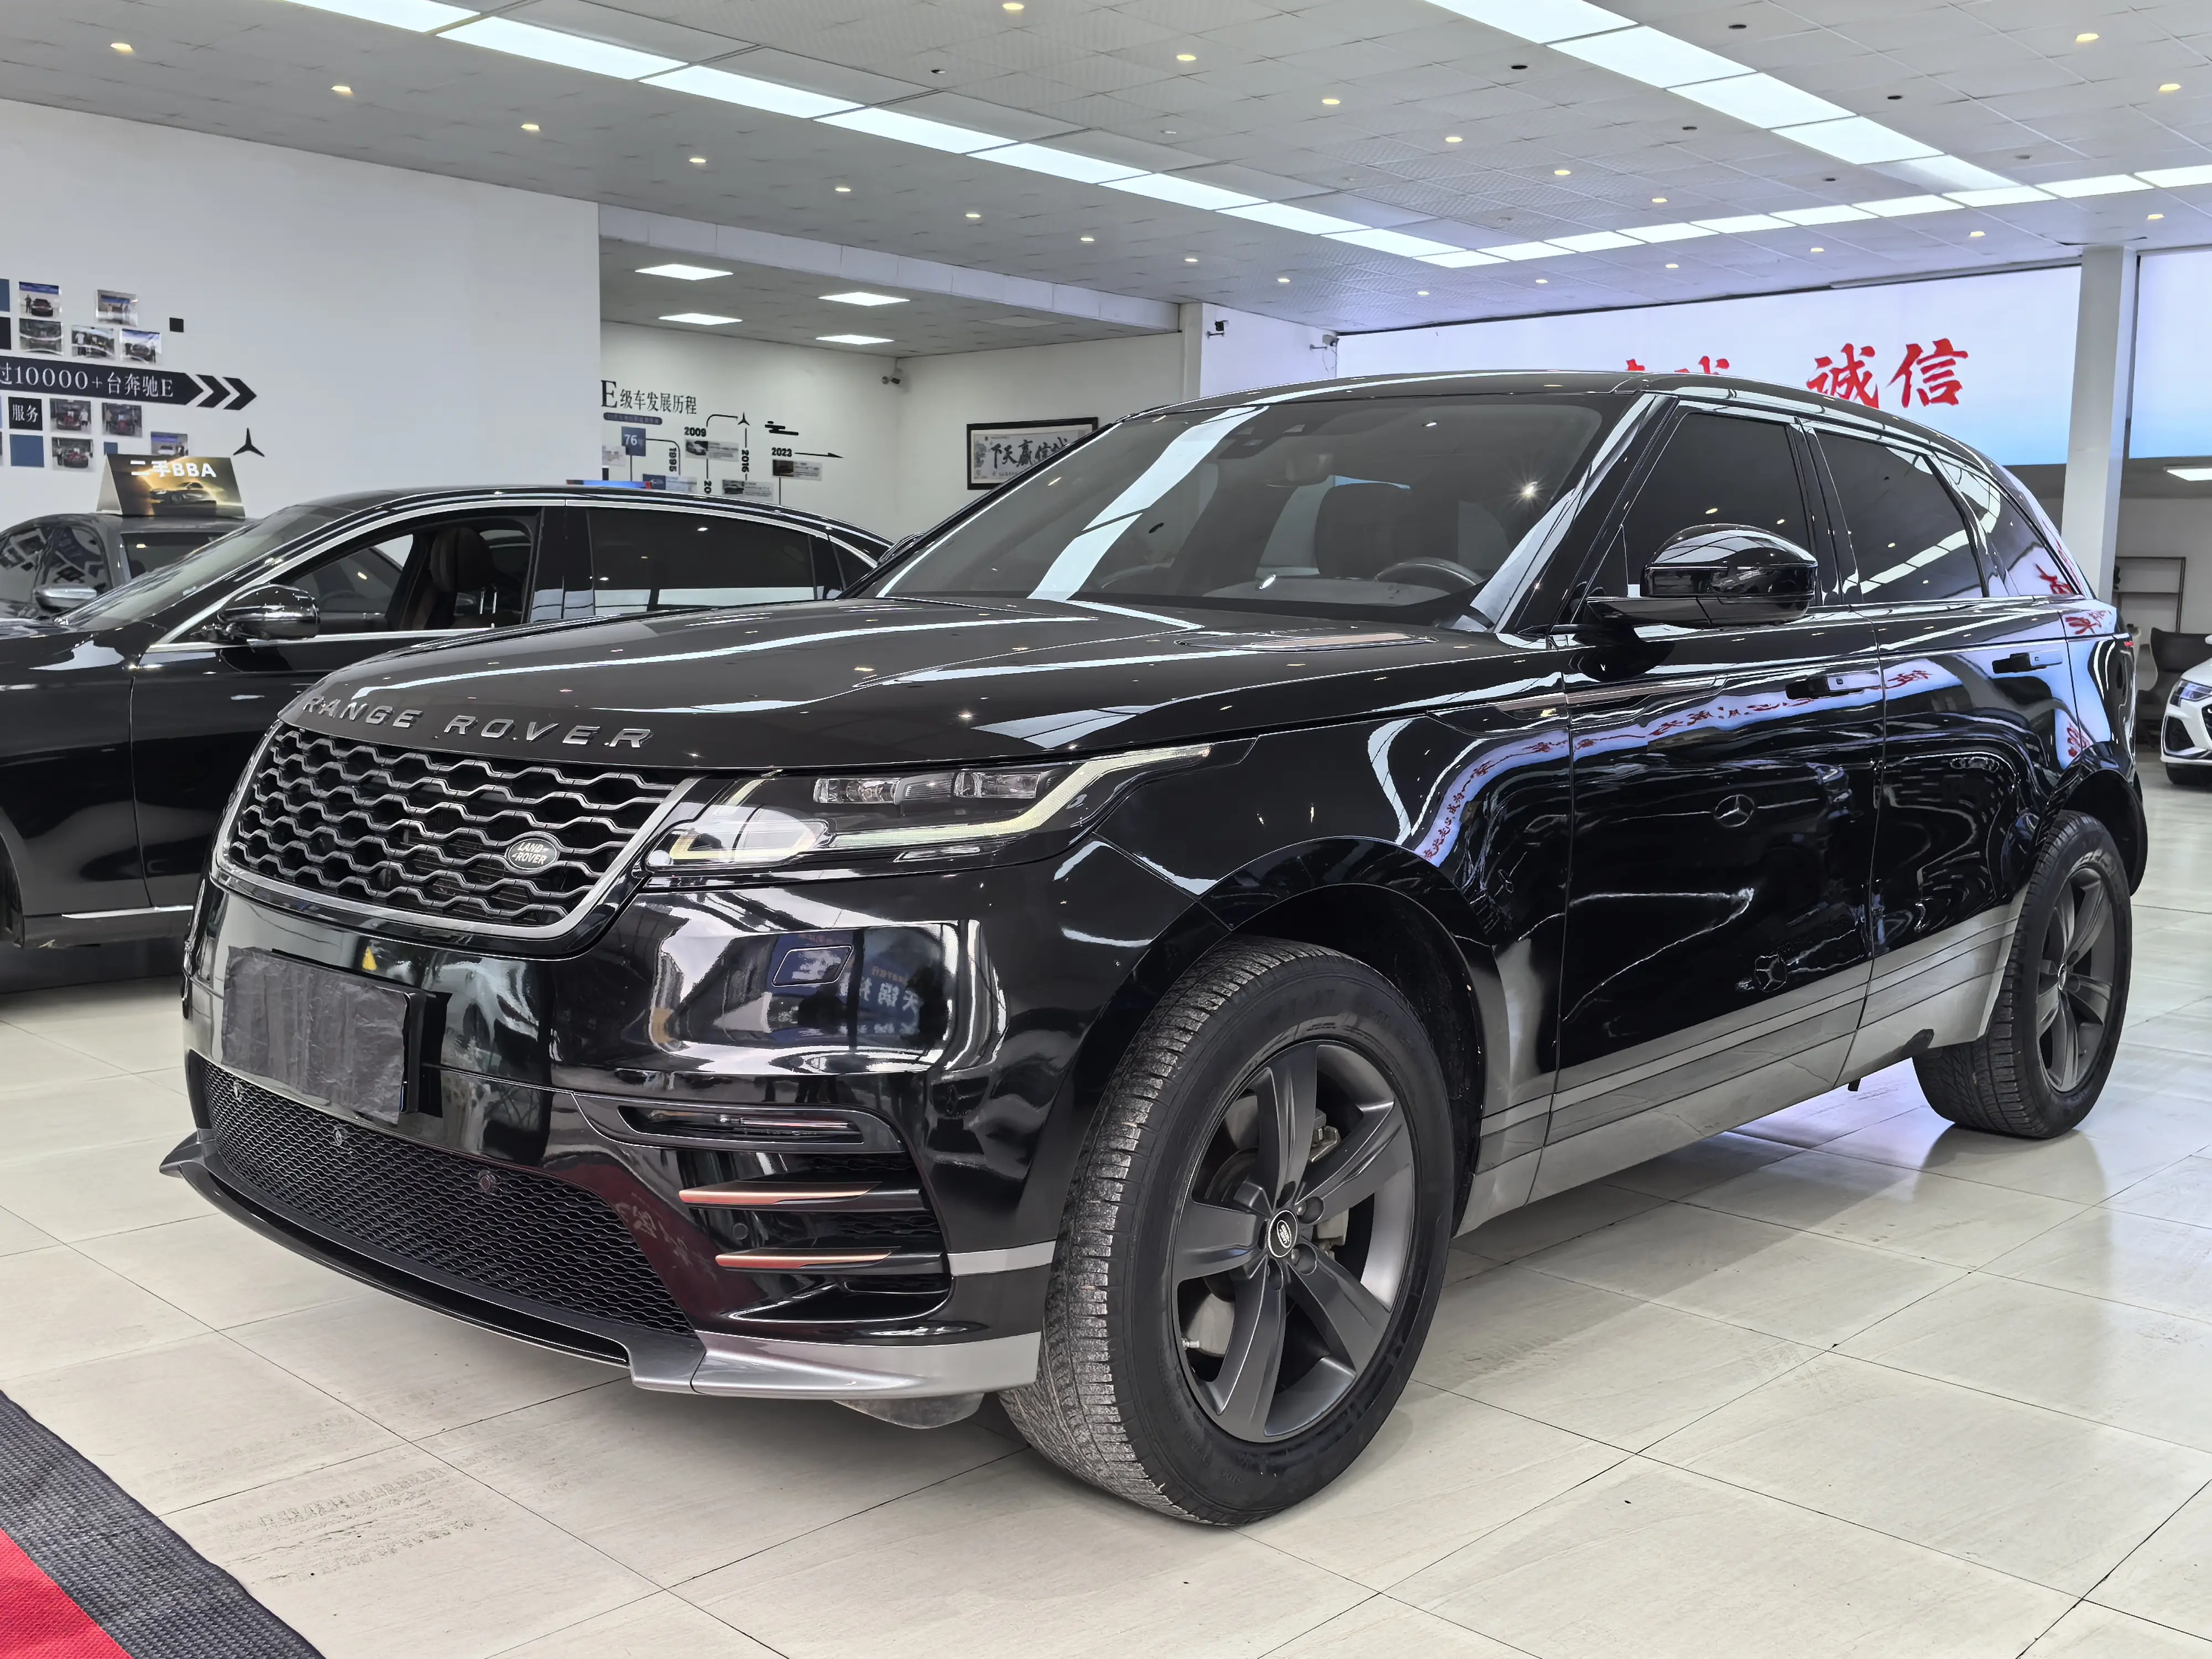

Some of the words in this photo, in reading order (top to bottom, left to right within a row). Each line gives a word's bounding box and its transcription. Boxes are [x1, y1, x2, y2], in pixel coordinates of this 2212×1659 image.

[1806, 338, 1968, 409] 诚信
[601, 380, 697, 415] E级车发展历程
[12, 404, 39, 423] 服务
[684, 427, 707, 437] 2009
[669, 447, 677, 472] 1995
[771, 447, 792, 457] 2023
[130, 460, 217, 478] 二手BBA
[302, 695, 424, 728] RANGE
[444, 714, 654, 748] ROVER
[517, 842, 545, 853] LAND
[514, 852, 547, 865] ROVER
